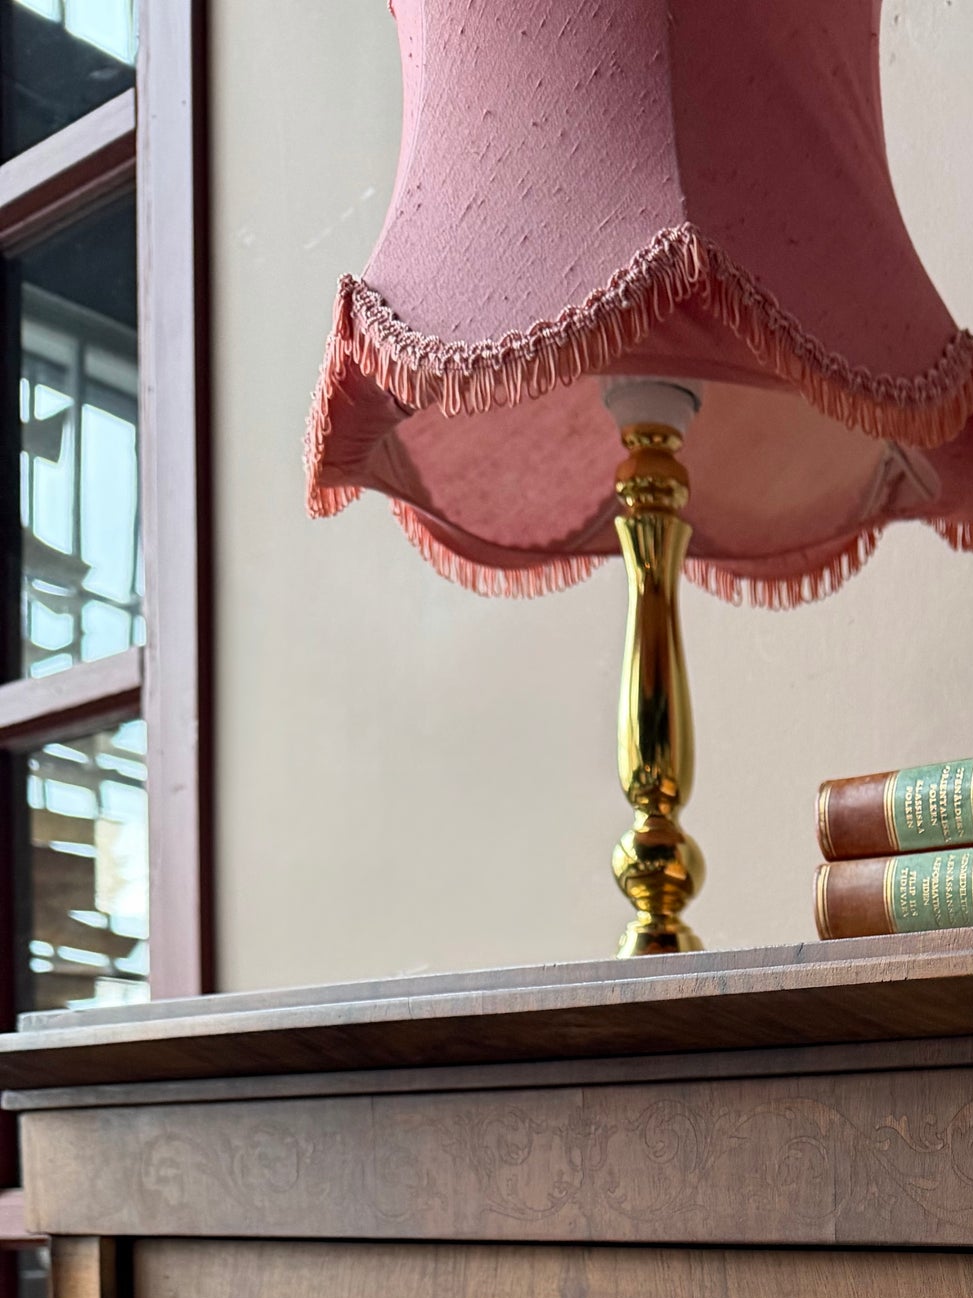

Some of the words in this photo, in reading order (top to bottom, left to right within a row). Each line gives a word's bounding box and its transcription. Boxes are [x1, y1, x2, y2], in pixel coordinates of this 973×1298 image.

[904, 786, 914, 829] FOLKEN
[929, 783, 938, 826] FOLKEN
[921, 876, 930, 906] TIDEN
